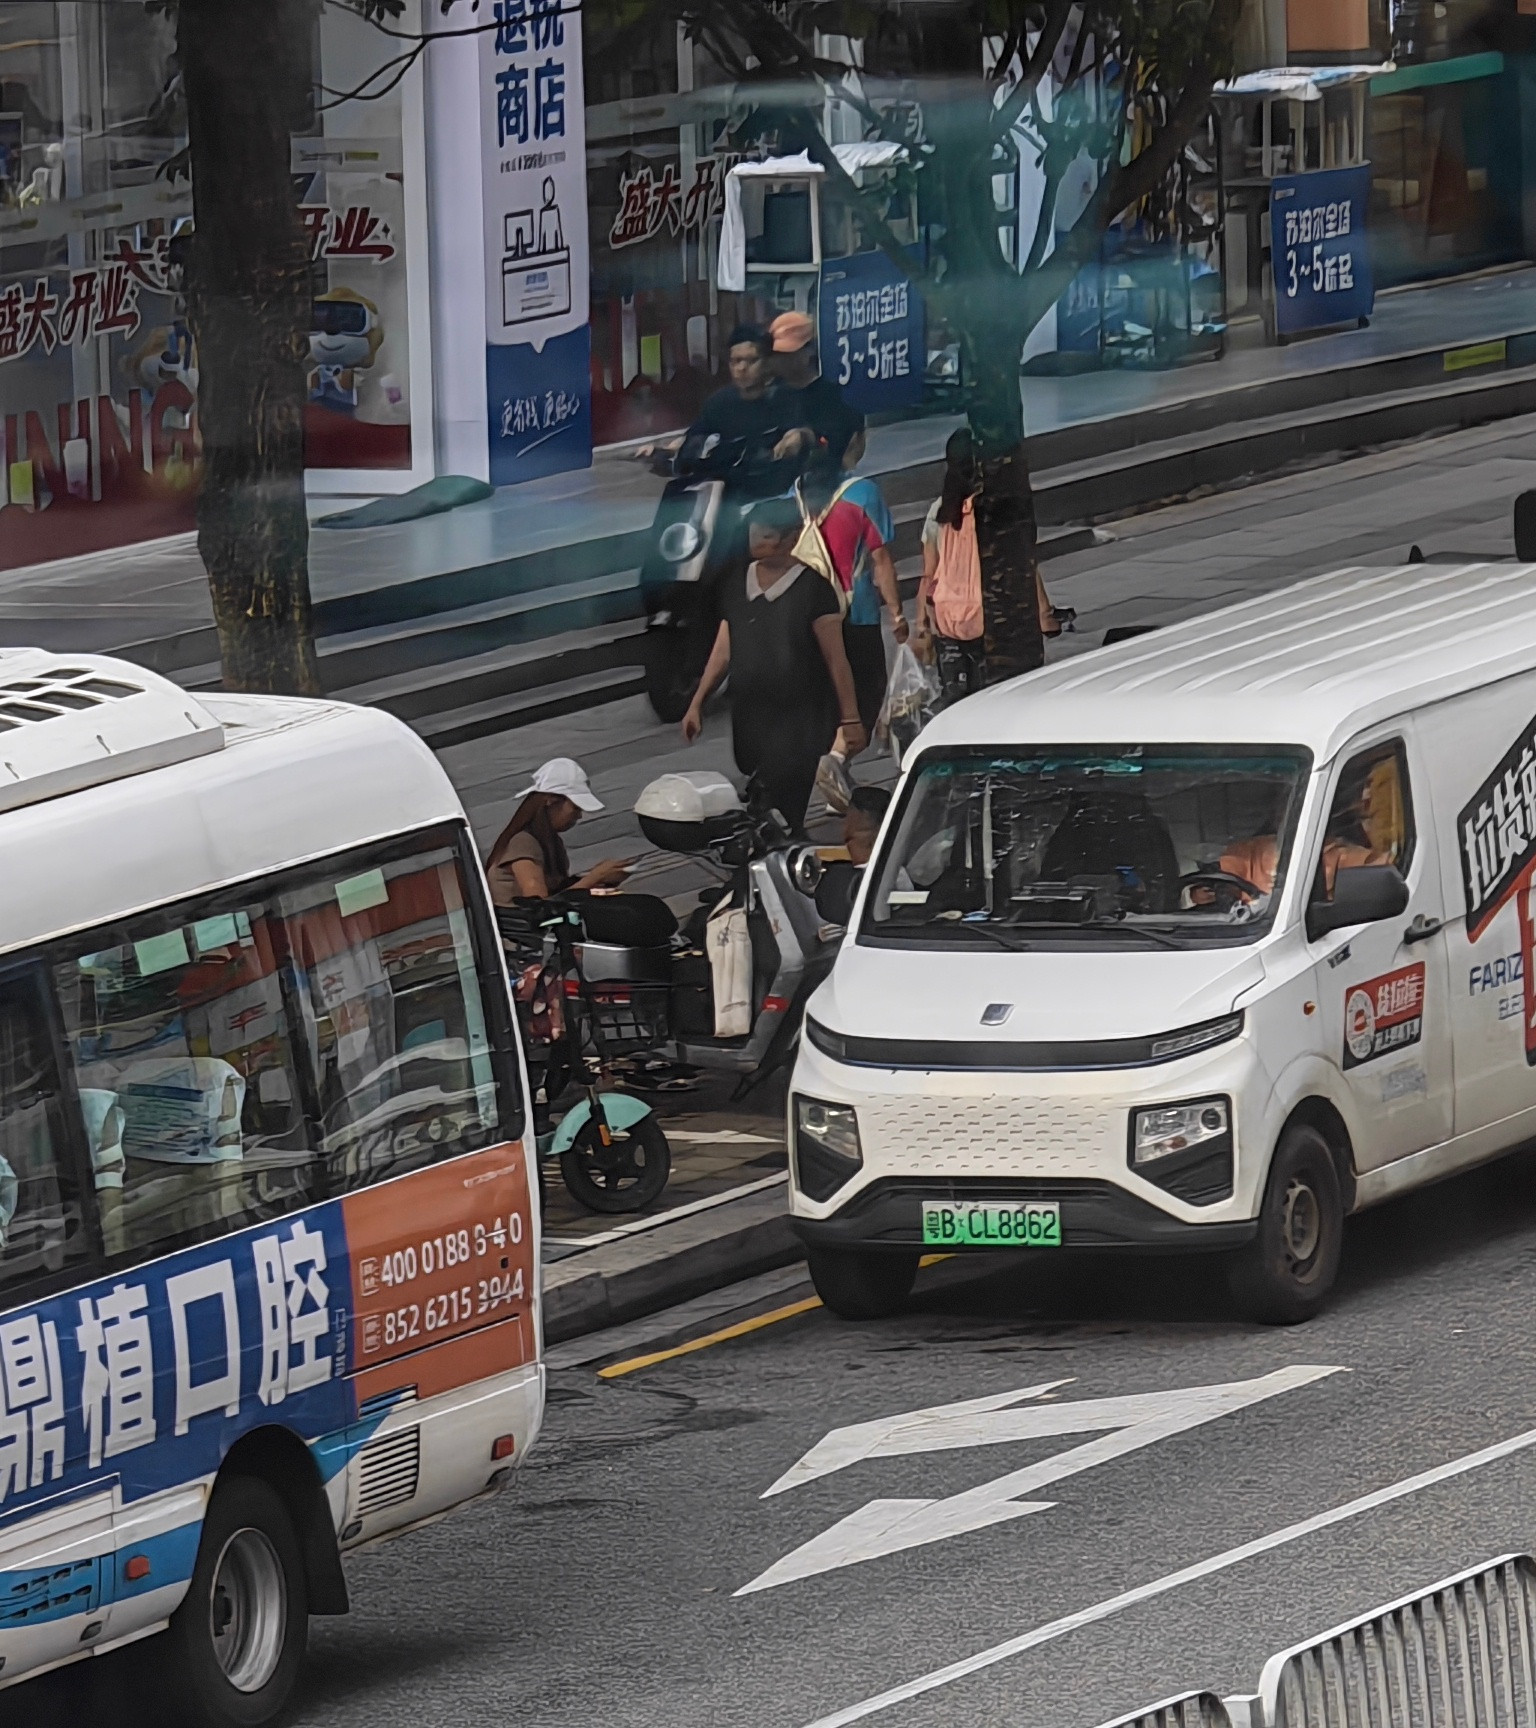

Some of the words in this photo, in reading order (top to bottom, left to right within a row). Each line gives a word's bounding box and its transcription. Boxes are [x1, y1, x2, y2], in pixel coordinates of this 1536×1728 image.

[495, 57, 565, 148] 商店
[381, 1247, 417, 1287] 400
[421, 1229, 470, 1274] 0188
[384, 1303, 420, 1345] 852
[425, 1286, 472, 1331] 6215
